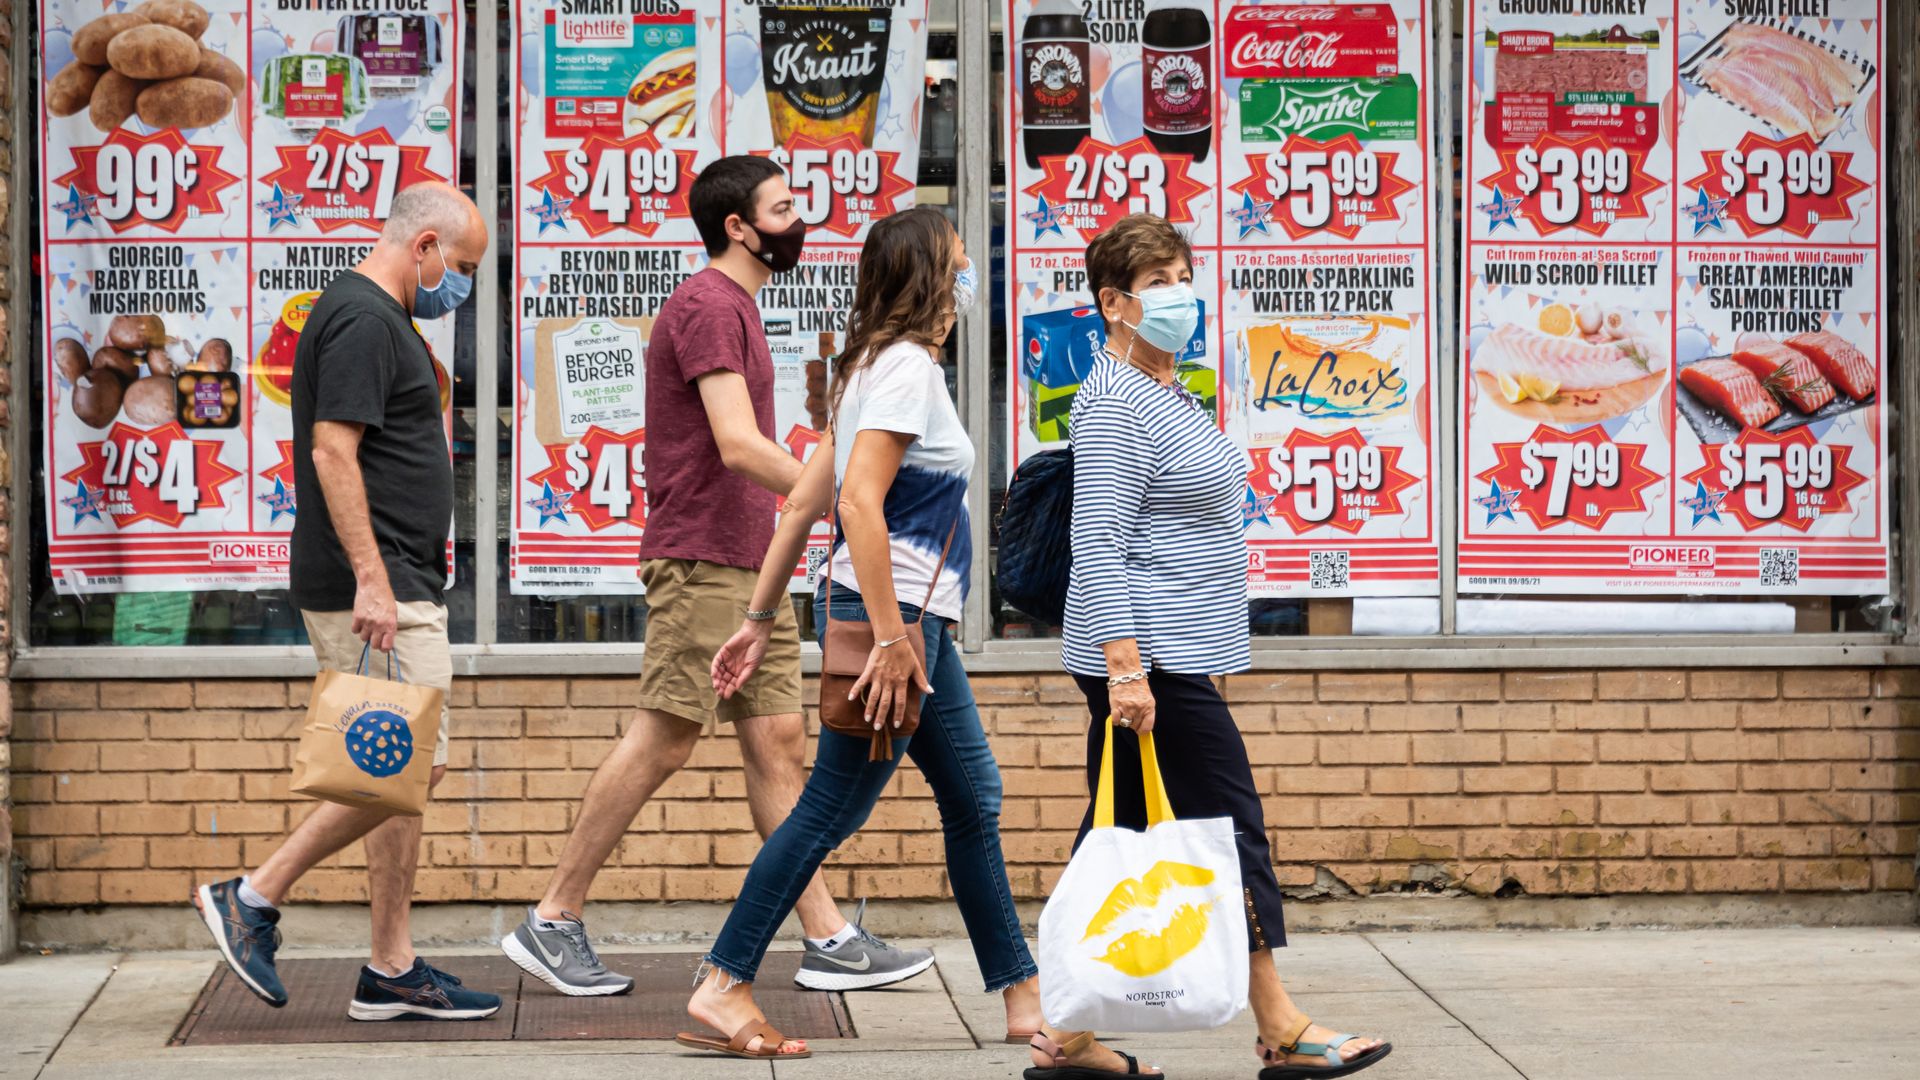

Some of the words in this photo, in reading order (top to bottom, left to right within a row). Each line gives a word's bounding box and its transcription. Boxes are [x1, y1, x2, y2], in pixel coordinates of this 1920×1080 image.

[561, 0, 625, 15] SMART
[630, 0, 681, 15] DOGS
[1082, 0, 1094, 21] 2
[1097, 0, 1145, 21] LITER
[1498, 0, 1574, 15] GROUND
[1579, 0, 1647, 15] TURKEY
[1724, 0, 1774, 16] SWAI
[1778, 0, 1829, 16] FILLET
[792, 19, 857, 40] CLEVELAND
[1090, 22, 1140, 43] SODA
[1386, 26, 1397, 35] 12
[1502, 36, 1525, 46] SHADY
[1526, 36, 1550, 46] BROOK
[1231, 31, 1344, 69] Coca-Cola
[1340, 48, 1373, 56] ORIGINAL
[555, 54, 586, 64] Smart
[587, 54, 612, 66] Dogs
[772, 41, 879, 85] Kraut
[1241, 90, 1252, 99] 12
[1582, 94, 1598, 102] LEAN
[1278, 93, 1364, 131] Sprite
[1502, 106, 1512, 118] NO
[1376, 120, 1416, 128] LEMON-LIME
[1502, 120, 1512, 132] NO
[1571, 118, 1598, 128] ground
[1598, 118, 1624, 128] turkey
[640, 198, 653, 209] 12
[655, 198, 670, 209] oz.
[845, 198, 858, 210] 16
[860, 199, 877, 210] oz.
[1065, 204, 1089, 215] 67.6
[1090, 204, 1108, 215] oz.
[1337, 200, 1358, 212] 144
[1360, 201, 1376, 212] oz.
[1590, 197, 1604, 209] 16
[1605, 198, 1621, 209] oz.
[303, 205, 370, 219] clamshells
[1073, 216, 1099, 229] btls.
[108, 246, 184, 268] GIORGIO
[286, 246, 374, 267] NATURES
[561, 251, 632, 271] BEYOND
[635, 251, 682, 271] MEAT
[799, 251, 837, 263] Based
[1030, 256, 1042, 268] 12
[1044, 257, 1060, 268] oz.
[1063, 256, 1085, 268] Can
[1234, 254, 1245, 266] 12
[1248, 256, 1265, 266] oz.
[1268, 253, 1354, 266] Cans-Assorted
[1357, 252, 1411, 266] Varieties
[1487, 249, 1504, 262] Cut
[1506, 249, 1535, 262] from
[1538, 249, 1618, 262] Frozen-at-Sea
[1621, 249, 1656, 262] Scrod
[1688, 250, 1726, 263] Frozen
[1728, 252, 1741, 263] or
[1744, 250, 1791, 265] Thawed,
[1794, 251, 1820, 263] Wild
[1823, 251, 1864, 265] Caught
[94, 269, 143, 291] BABY
[146, 268, 200, 290] BELLA
[1053, 271, 1086, 292] PEP
[1231, 267, 1308, 290] LACROIX
[1312, 266, 1415, 290] SPARKLING
[1485, 264, 1532, 286] WILD
[1536, 264, 1599, 286] SCROD
[1603, 264, 1657, 286] FILLET
[1699, 265, 1756, 287] GREAT
[1760, 266, 1853, 288] AMERICAN
[550, 273, 625, 295] BEYOND
[89, 292, 206, 315] MUSHROOMS
[761, 288, 827, 310] ITALIAN
[1252, 291, 1318, 313] WATER
[1322, 291, 1341, 312] 12
[1344, 290, 1393, 312] PACK
[1710, 289, 1784, 310] SALMON
[1788, 289, 1842, 310] FILLET
[524, 297, 643, 318] PLANT-BASED
[799, 311, 846, 332] LINKS
[1731, 311, 1822, 333] PORTIONS
[574, 337, 602, 347] BEYOND
[602, 336, 620, 344] MEAT
[771, 346, 804, 354] AUSAGE
[565, 348, 633, 369] BEYOND
[567, 363, 635, 384] BURGER
[572, 384, 633, 398] PLANT-BASED
[587, 395, 622, 406] PATTIES
[570, 413, 591, 424] 20G
[565, 440, 647, 518] $49
[1341, 494, 1362, 507] 144
[1363, 494, 1380, 507] oz.
[1794, 492, 1808, 505] 16
[1809, 493, 1826, 505] oz.
[213, 544, 289, 559] PIONEER
[1633, 548, 1710, 562] PIONEER
[528, 566, 547, 574] GOOD
[549, 566, 567, 574] UNTIL
[1468, 577, 1487, 585] GOOD
[1488, 577, 1507, 585] UNTIL
[1642, 580, 1741, 588] PIONEERSUPERMARKETS.COM
[1125, 989, 1185, 1002] NORDSTROM
[1145, 1000, 1166, 1008] beauty
